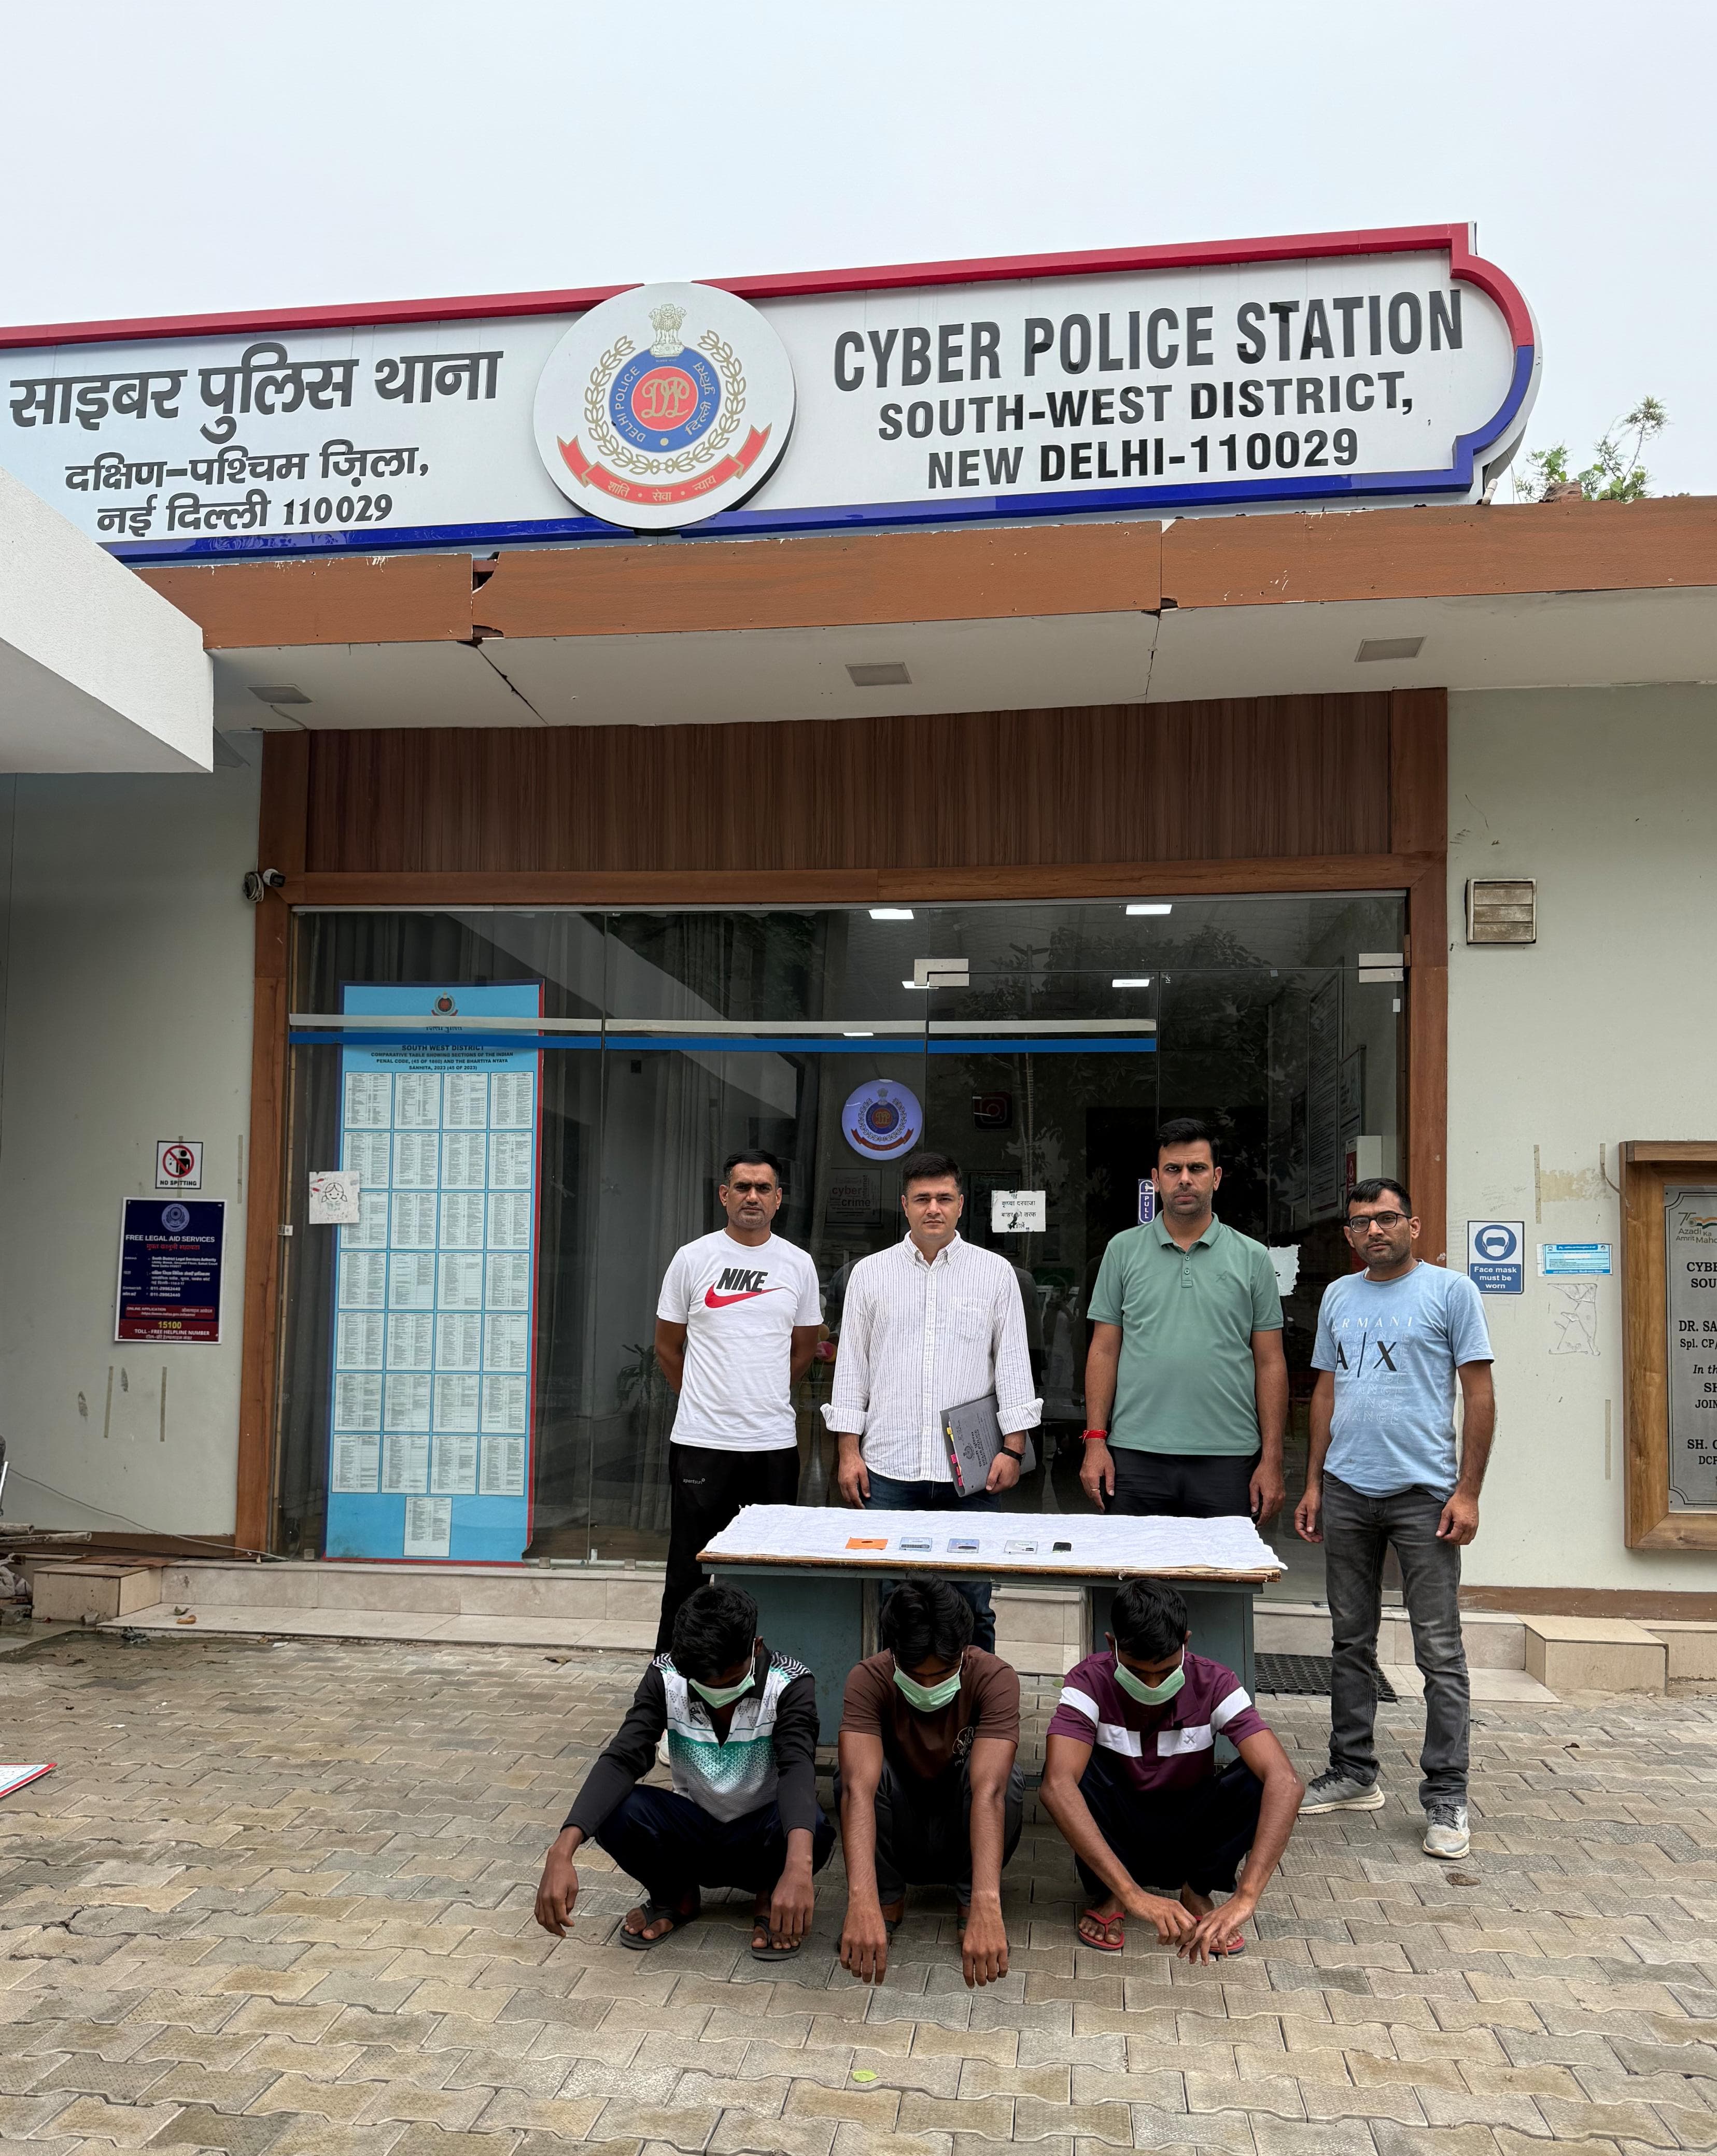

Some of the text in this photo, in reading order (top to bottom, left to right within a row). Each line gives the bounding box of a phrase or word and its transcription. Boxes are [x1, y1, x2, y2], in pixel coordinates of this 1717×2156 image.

[834, 288, 1464, 392] CYBER POLICE STATION
[9, 342, 504, 445] साइबर पुलिस थाना
[615, 365, 646, 443] DELHI POLICE
[878, 370, 1414, 442] SOUTH-WEST DISTRICT,
[64, 445, 309, 492] दक्षिण-पश्चिम
[928, 428, 1359, 489] NEW DELHI-110029
[607, 475, 717, 501] शांति सेवा न्याय
[97, 488, 393, 537] नई दिल्ली 110029
[832, 1185, 862, 1197] cyber
[841, 1198, 870, 1207] crime
[716, 1268, 768, 1293] NIKE
[1679, 1321, 1699, 1331] DR.
[1680, 1338, 1698, 1350] Spl.
[1693, 1365, 1704, 1374] In
[1687, 1439, 1708, 1450] SH.
